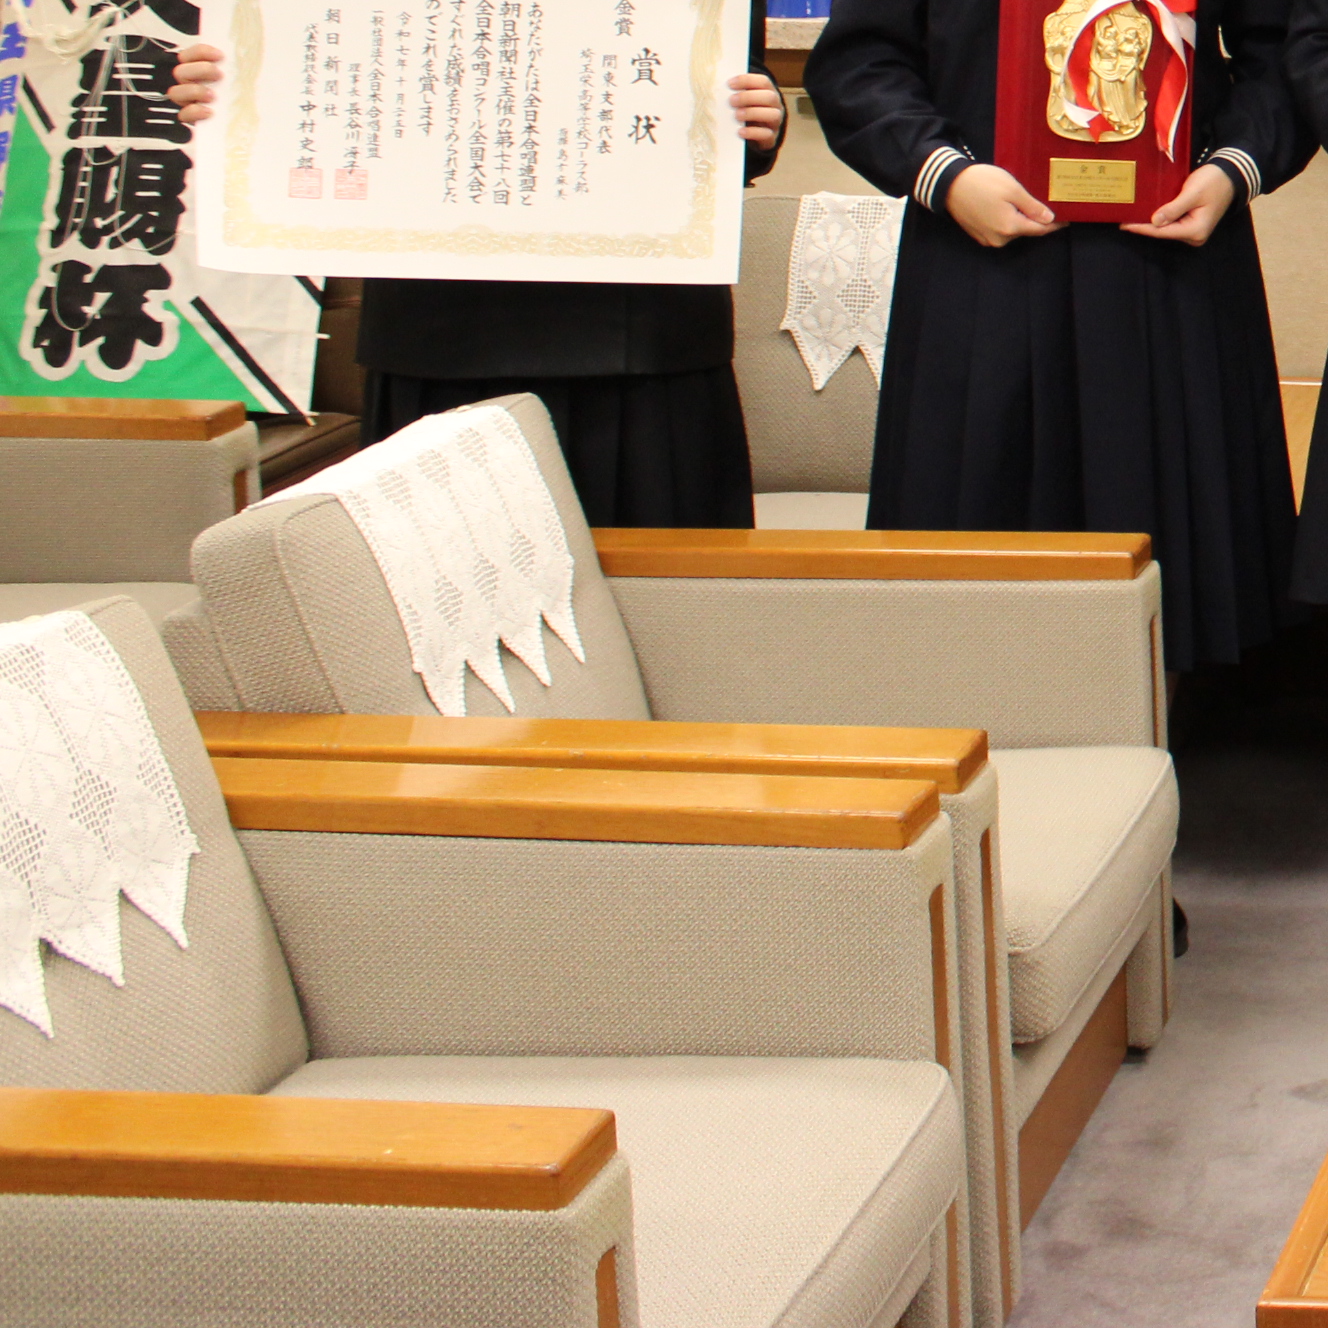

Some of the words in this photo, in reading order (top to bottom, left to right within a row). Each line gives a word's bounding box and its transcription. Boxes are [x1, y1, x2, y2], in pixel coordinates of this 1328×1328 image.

[323, 8, 342, 118] 朝日新聞社
[493, 0, 521, 206] 朝日新聞社主催の第七十八回
[518, 1, 543, 206] あなたがたは全日本合唱連盟と
[596, 54, 618, 154] 関東支部代表
[627, 47, 662, 145] 賞状
